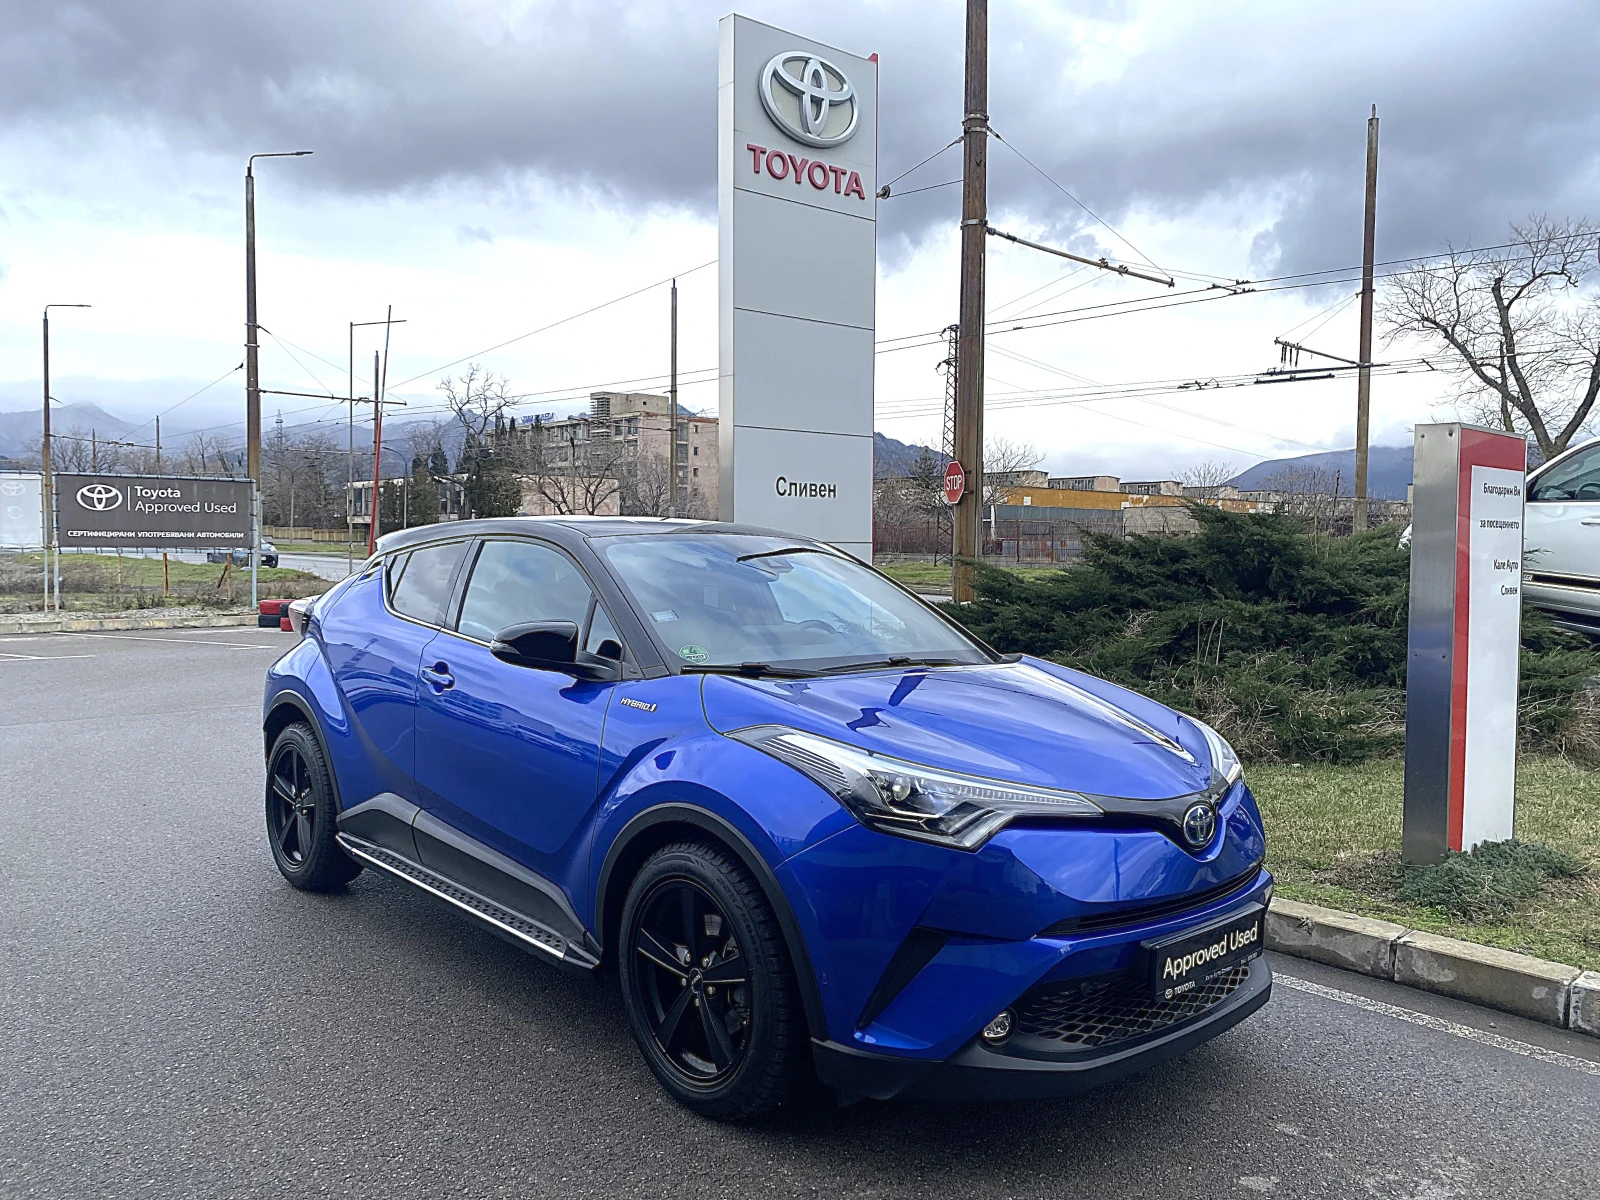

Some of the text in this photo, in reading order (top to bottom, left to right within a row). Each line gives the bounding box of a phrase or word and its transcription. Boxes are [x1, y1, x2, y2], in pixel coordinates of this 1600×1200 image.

[746, 143, 866, 201] TOYOTA
[776, 476, 837, 498] Сливен
[946, 474, 962, 491] STOP
[134, 485, 181, 500] Toyota
[134, 500, 237, 515] Approved Used
[67, 530, 136, 538] СЕРТИФИЦИРАНИ
[137, 531, 195, 539] УПОТРЕБЯВАНИ
[620, 697, 650, 711] HYBRID
[1162, 920, 1258, 980] Approved Used
[1174, 980, 1196, 996] TOYOTA
